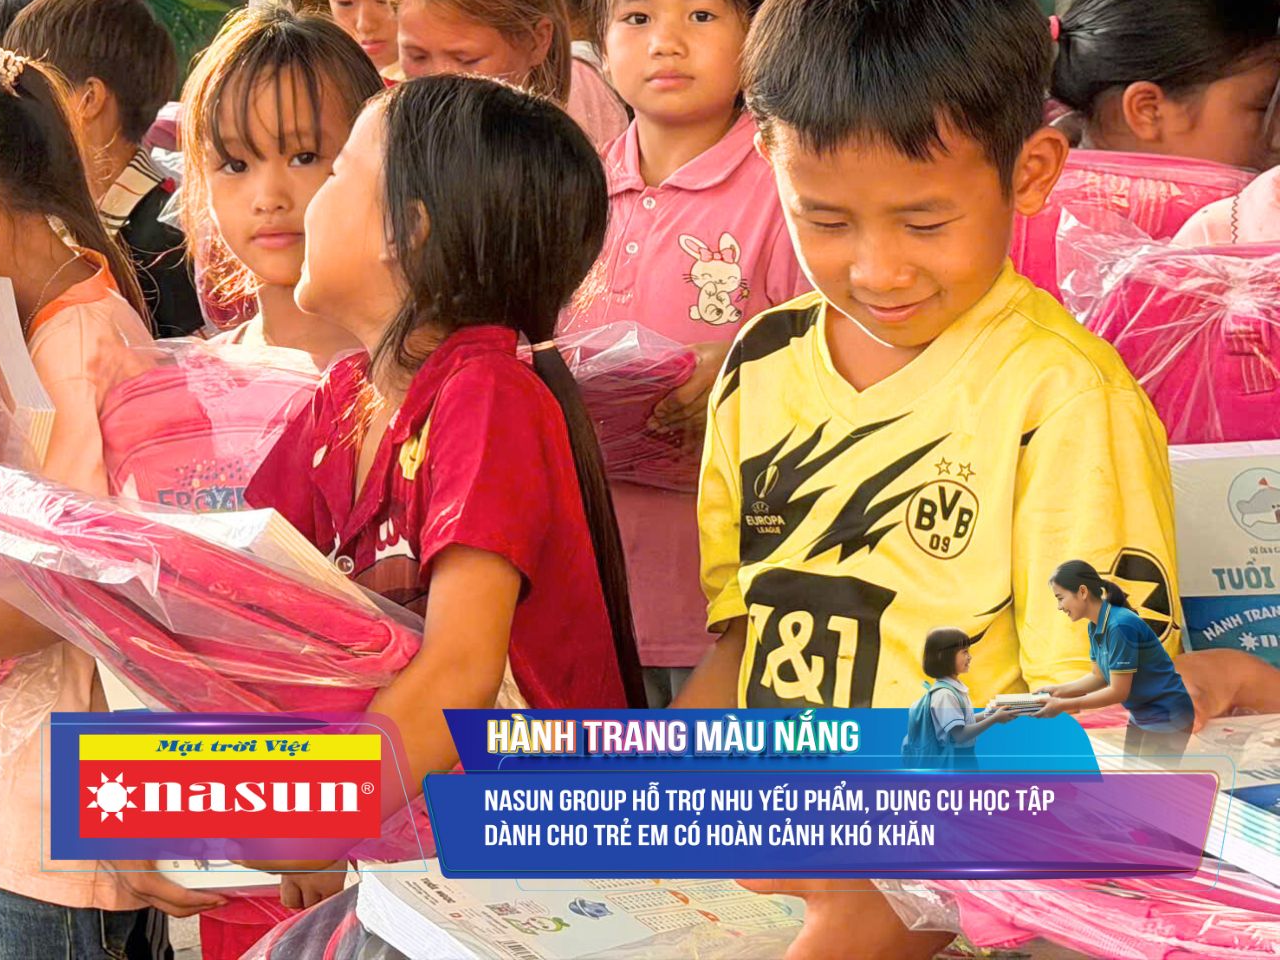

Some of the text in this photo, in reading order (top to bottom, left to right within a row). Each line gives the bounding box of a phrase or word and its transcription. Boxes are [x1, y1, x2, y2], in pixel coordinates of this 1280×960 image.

[745, 514, 785, 527] EUROPA
[914, 485, 974, 539] BVB
[928, 533, 951, 554] 09
[1203, 611, 1243, 641] HÀNH
